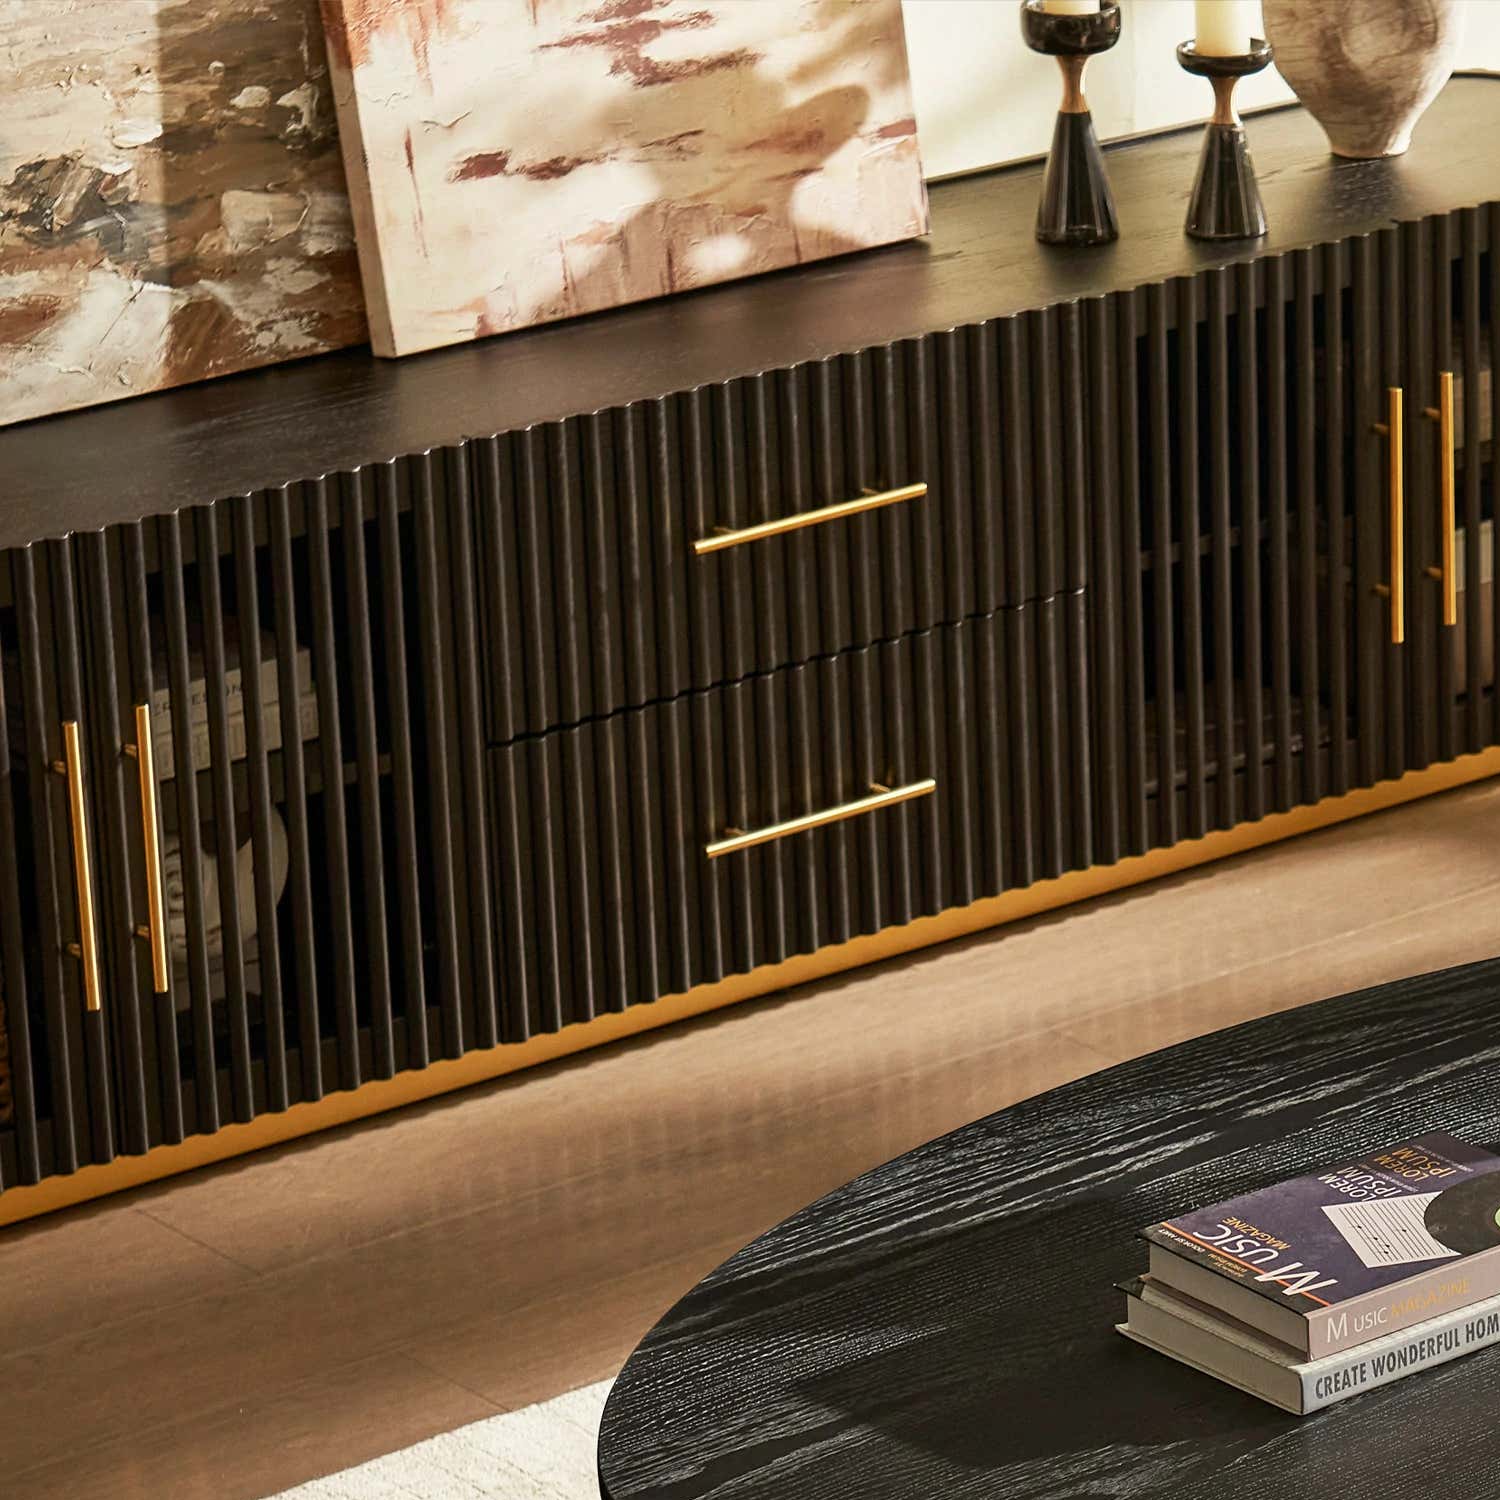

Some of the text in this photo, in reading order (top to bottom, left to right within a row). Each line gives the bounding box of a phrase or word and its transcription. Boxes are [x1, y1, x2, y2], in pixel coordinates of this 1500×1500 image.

[1373, 1154, 1430, 1182] LOREM
[1391, 1146, 1457, 1179] IPSUM
[1317, 1173, 1377, 1202] LOREM
[1336, 1166, 1402, 1198] IPSUM
[1222, 1216, 1291, 1250] MAGAZINE
[1391, 1279, 1472, 1317] MAGAZINE
[1315, 1361, 1367, 1399] CREATE
[1371, 1327, 1461, 1379] WONDERFUL
